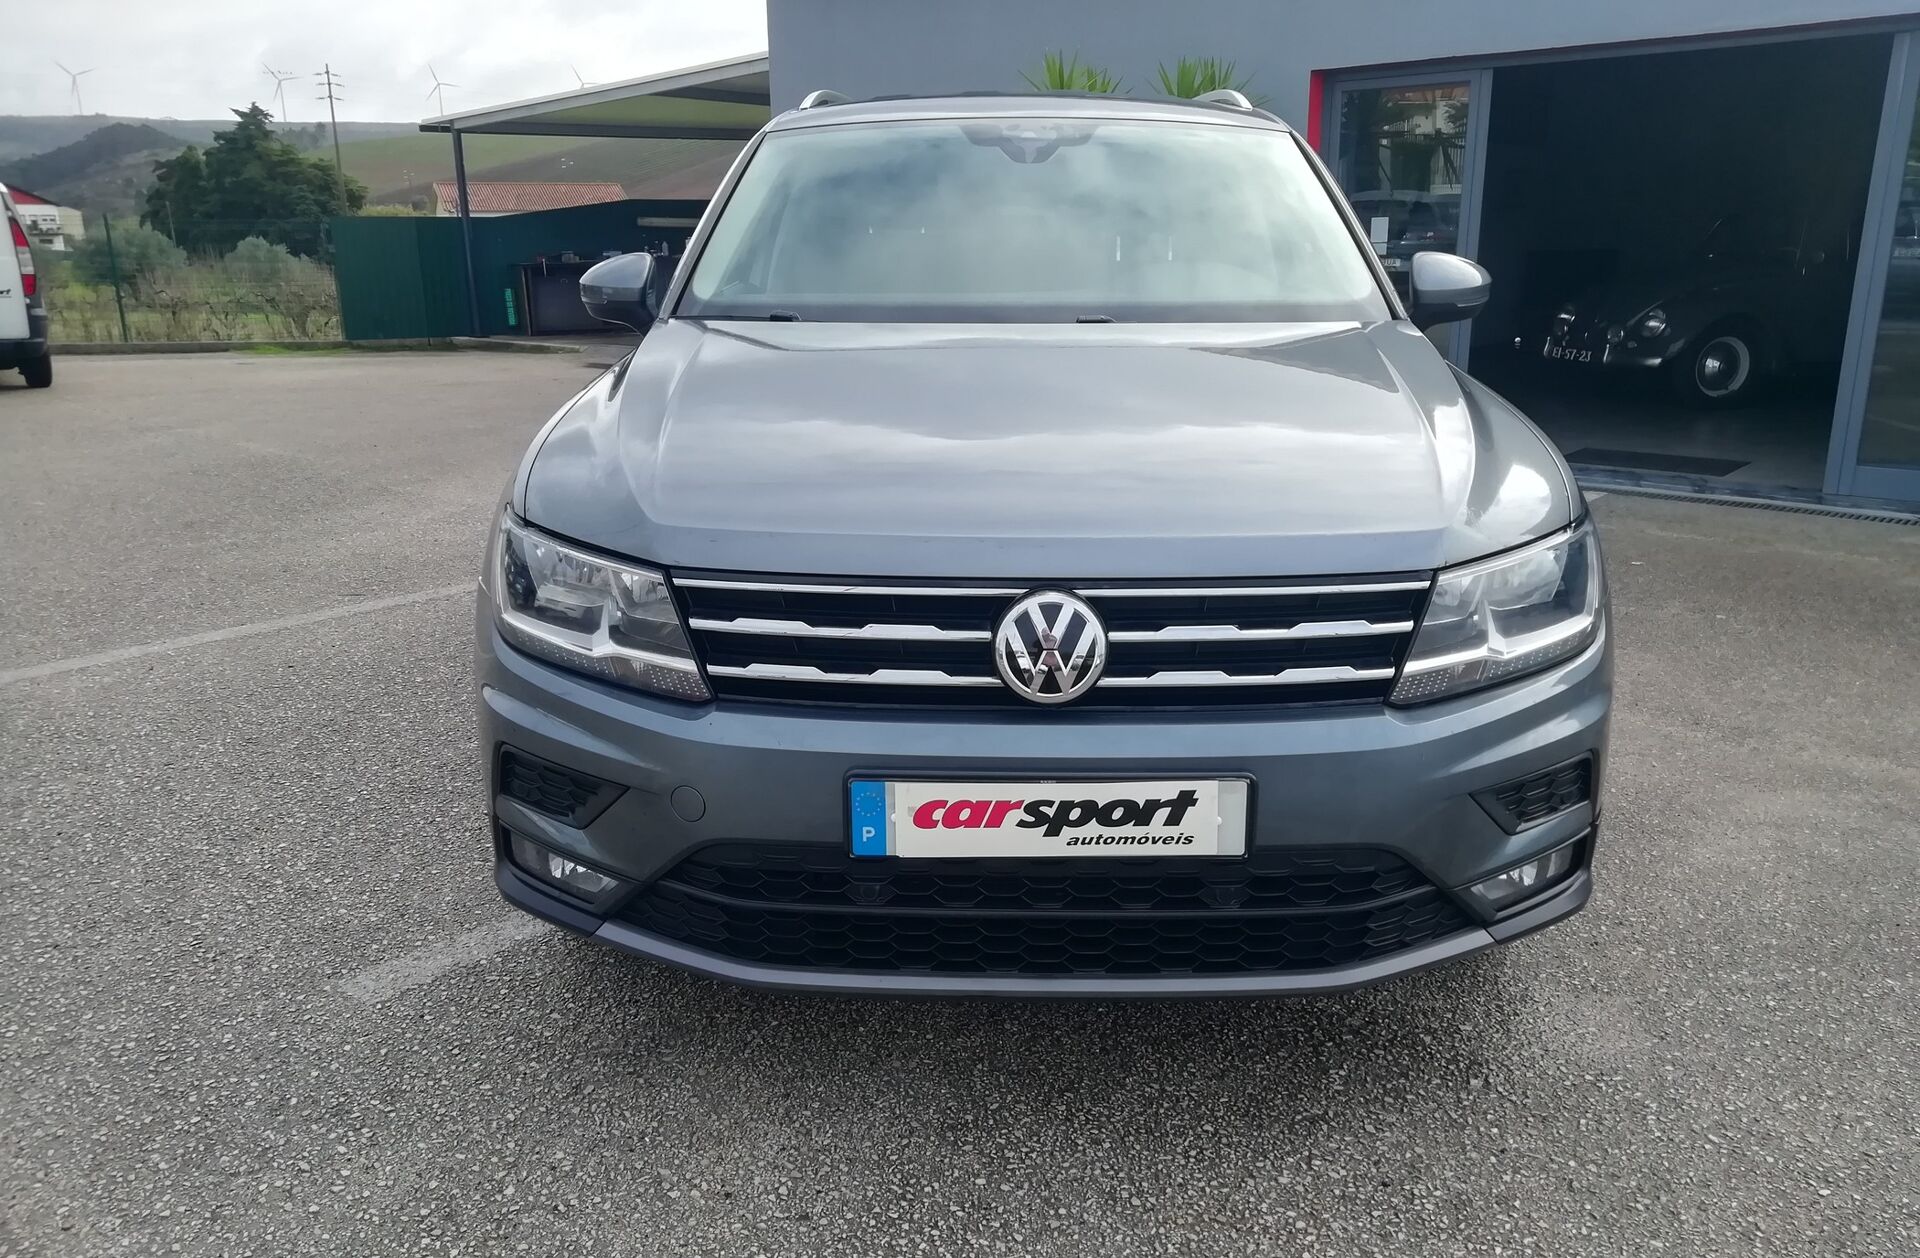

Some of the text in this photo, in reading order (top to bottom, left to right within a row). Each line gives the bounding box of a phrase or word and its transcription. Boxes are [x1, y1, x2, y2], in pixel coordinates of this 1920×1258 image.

[911, 789, 1199, 837] carsport
[862, 826, 876, 842] P
[1066, 832, 1195, 847] automóveis
